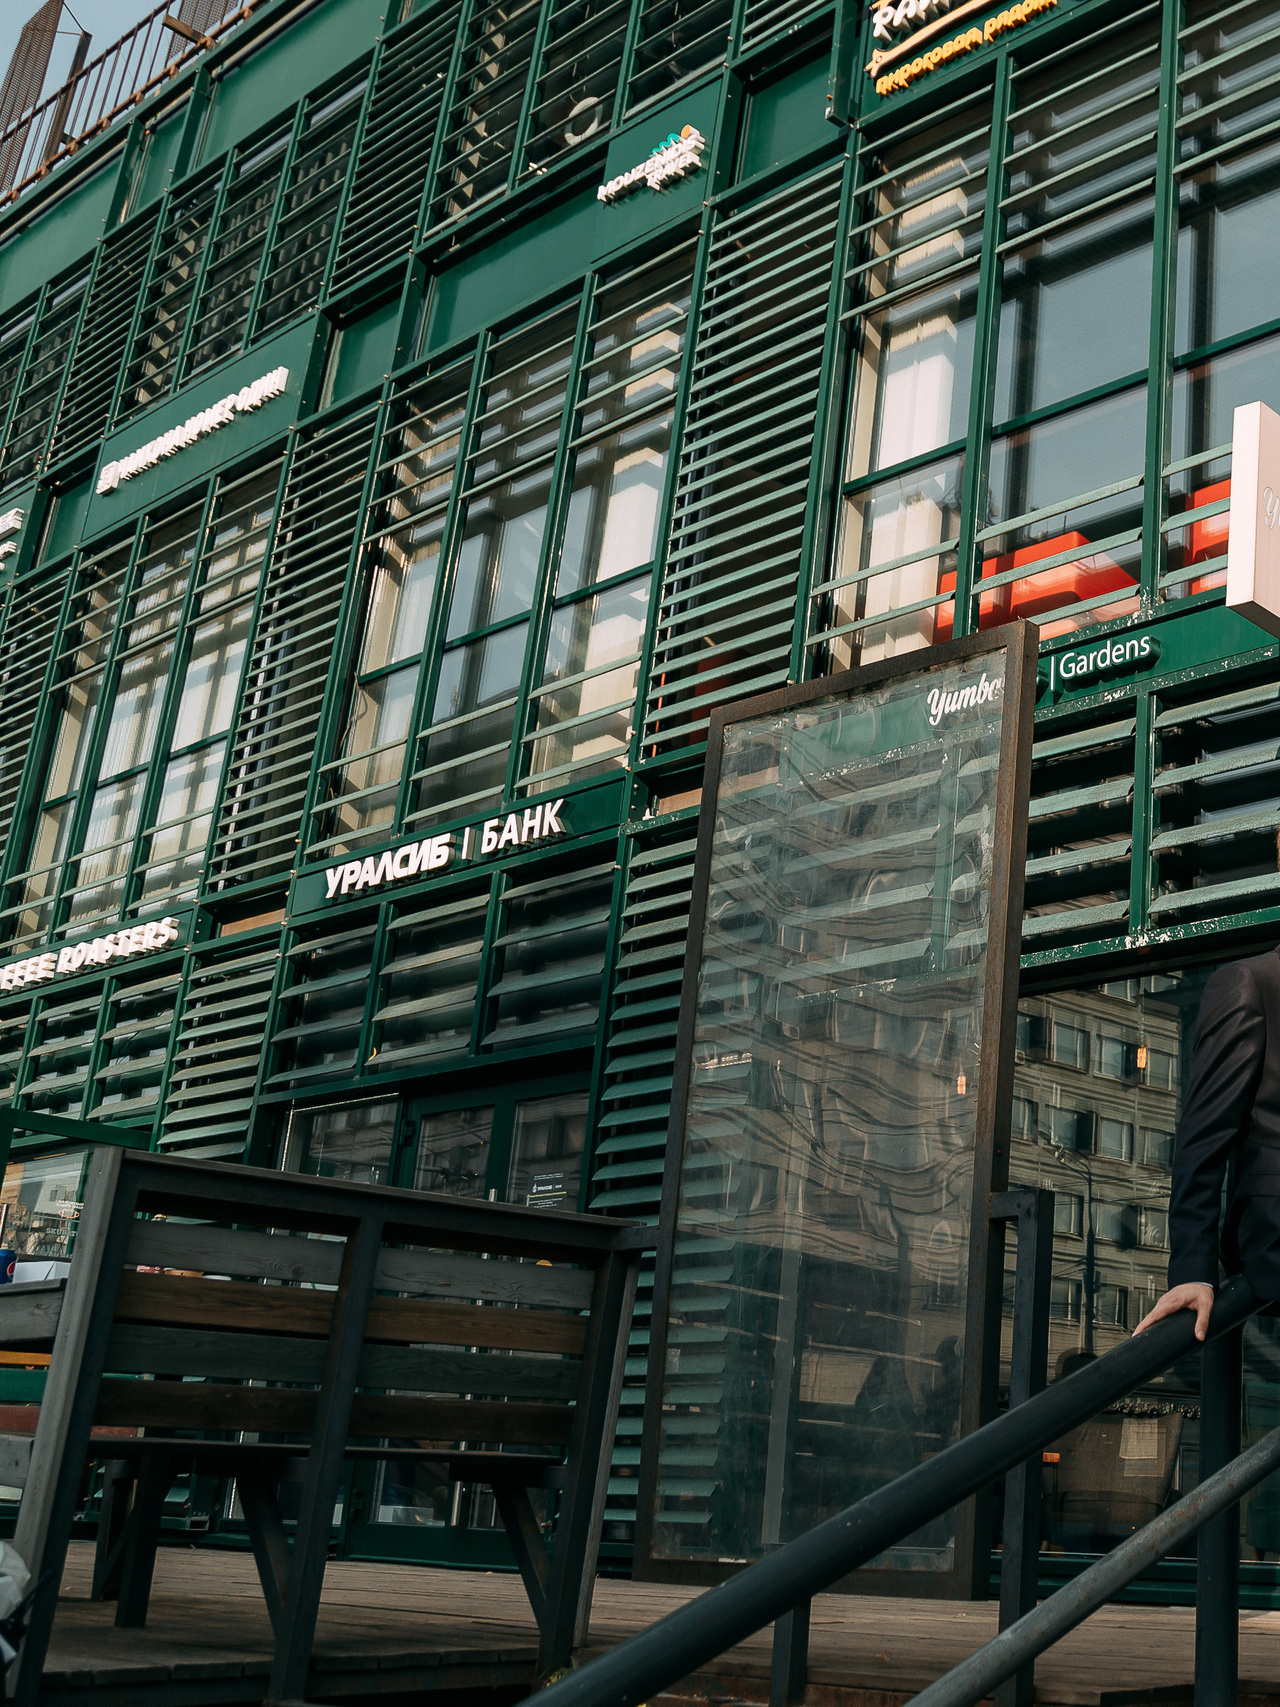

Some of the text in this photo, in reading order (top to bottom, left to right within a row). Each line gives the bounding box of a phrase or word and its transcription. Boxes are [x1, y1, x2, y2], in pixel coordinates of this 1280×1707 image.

[1059, 634, 1150, 679] Gardens
[325, 799, 567, 899] УРАЛСИБ БАНК
[0, 917, 180, 990] FFEE ROASTERS
[46, 1227, 79, 1238] SKURAT
